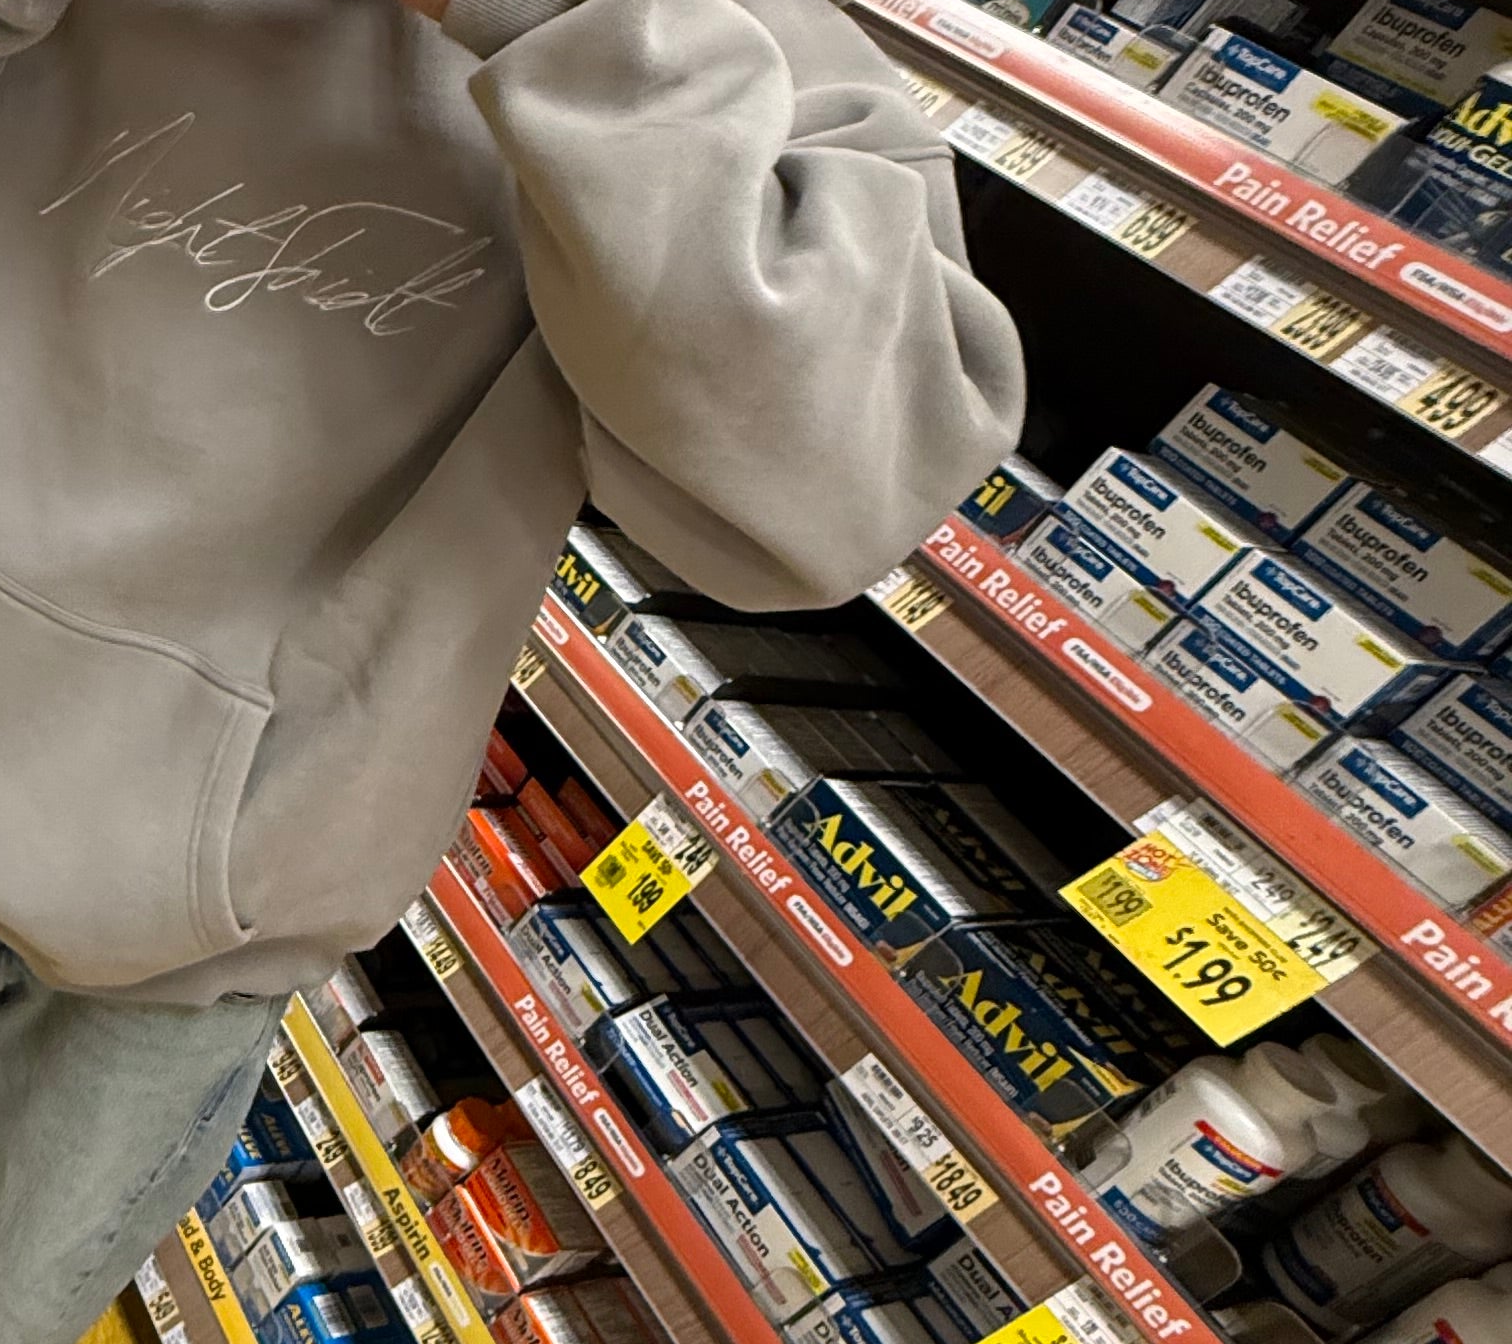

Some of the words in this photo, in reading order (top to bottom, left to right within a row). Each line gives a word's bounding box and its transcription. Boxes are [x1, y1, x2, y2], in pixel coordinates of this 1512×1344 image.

[1229, 44, 1287, 81] TopCare
[1371, 6, 1466, 59] Ibuprofen
[1193, 61, 1291, 123] Ibuprofen
[1233, 106, 1255, 125] 200
[1256, 117, 1273, 135] mg
[1213, 162, 1291, 216] Pain
[1285, 199, 1406, 270] Relief
[1189, 411, 1267, 473] Ibuprofen
[1226, 398, 1272, 433] TopCare
[1089, 476, 1167, 542] Ibuprofen
[1128, 462, 1170, 503] TopCare
[1337, 512, 1430, 583] Ibuprofen
[1384, 500, 1431, 542] TopCare
[926, 524, 989, 582] Pain
[981, 570, 1068, 640] Relief
[1069, 642, 1112, 680] FSA/HSA
[1029, 544, 1105, 610] Ibuprofen
[1274, 570, 1322, 611] TopCare
[1230, 578, 1320, 654] Ibuprofen
[614, 637, 661, 689] Ibuprofen
[1161, 649, 1247, 724] Ibuprofen
[692, 722, 744, 780] Ibuprofen
[685, 780, 729, 838] Pain
[725, 825, 793, 894] Relief
[1317, 767, 1416, 852] Ibuprofen
[801, 813, 919, 923] Advil
[1206, 912, 1248, 952] Save
[1400, 919, 1493, 1001] Pain
[541, 948, 572, 995] Action
[515, 994, 551, 1044] Pain
[544, 1040, 599, 1105] Relief
[640, 1010, 665, 1049] Dual
[664, 1043, 698, 1089] Action
[937, 969, 1075, 1092] Advil
[965, 1024, 983, 1043] 200
[975, 1038, 994, 1058] mg
[383, 1187, 431, 1263] Aspirin
[696, 1154, 728, 1203] Dual
[726, 1198, 771, 1259] Action
[189, 1236, 204, 1257] &
[198, 1255, 227, 1302] Body
[957, 1253, 999, 1302] Dual
[1029, 1173, 1095, 1247] Pain
[1090, 1242, 1192, 1339] Relief
